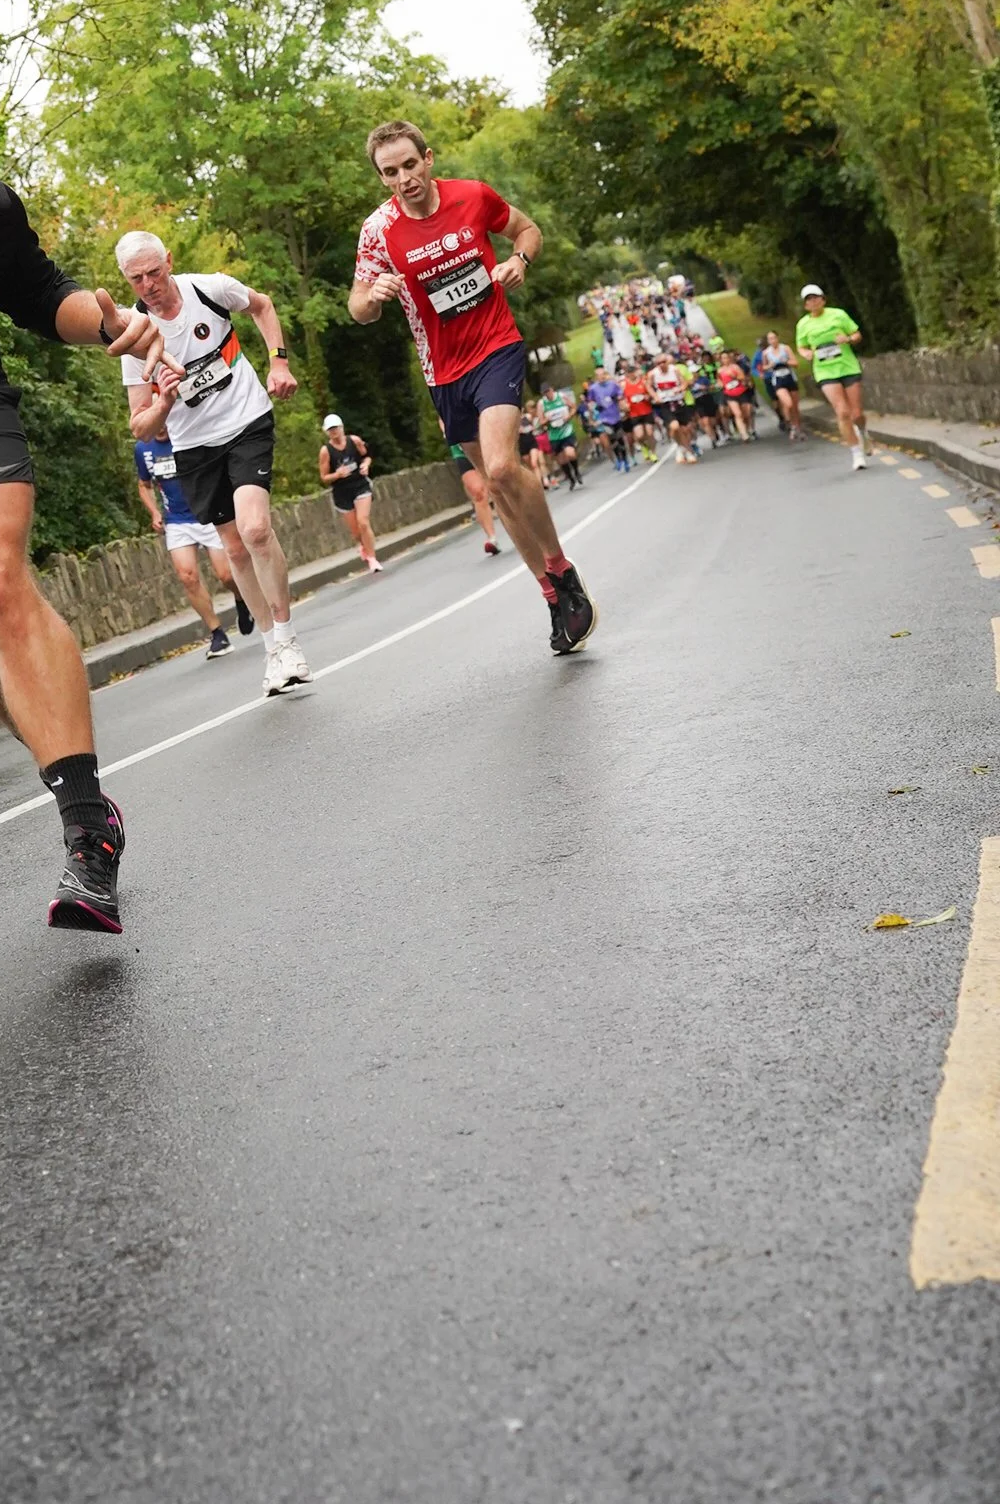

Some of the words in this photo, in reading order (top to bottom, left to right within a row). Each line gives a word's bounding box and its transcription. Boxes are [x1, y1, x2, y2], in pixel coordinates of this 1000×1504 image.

[406, 247, 424, 258] CORK
[425, 239, 441, 252] CITY
[407, 245, 442, 264] MARATHON
[417, 267, 437, 281] HALF
[438, 248, 478, 272] MARATHON
[441, 273, 457, 284] RACE
[457, 262, 477, 276] SERIES
[445, 278, 478, 302] 1129
[456, 303, 469, 313] Pop
[468, 299, 478, 308] Up
